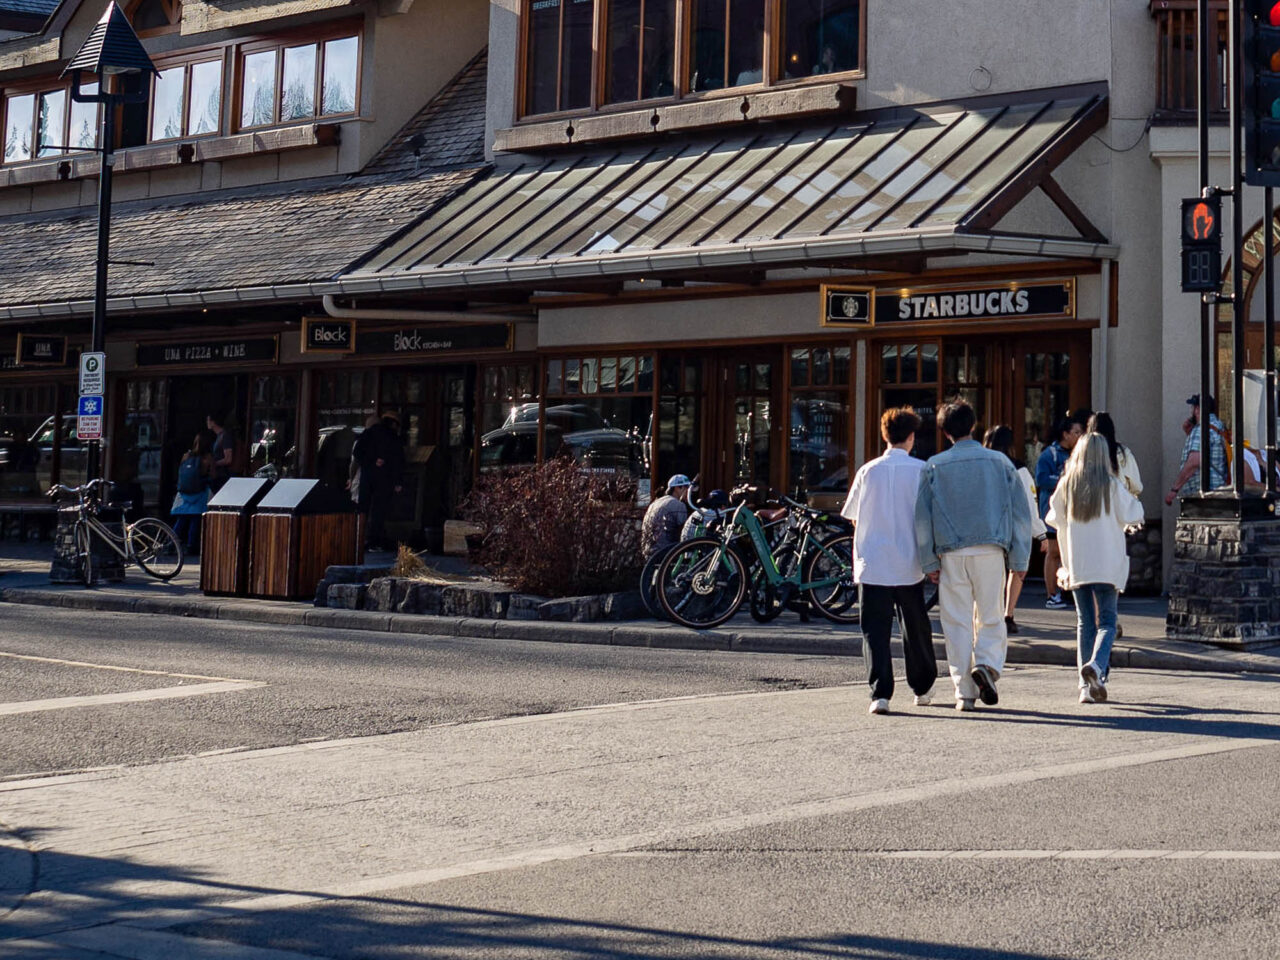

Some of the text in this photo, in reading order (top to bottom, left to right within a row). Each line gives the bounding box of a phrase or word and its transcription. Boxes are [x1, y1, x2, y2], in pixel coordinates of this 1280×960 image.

[899, 290, 1029, 320] STARBUCKS
[314, 326, 347, 343] Block
[393, 329, 422, 351] Block
[164, 348, 181, 361] UNA
[185, 346, 212, 360] PIZZA
[223, 343, 246, 358] WINE
[89, 359, 97, 370] P
